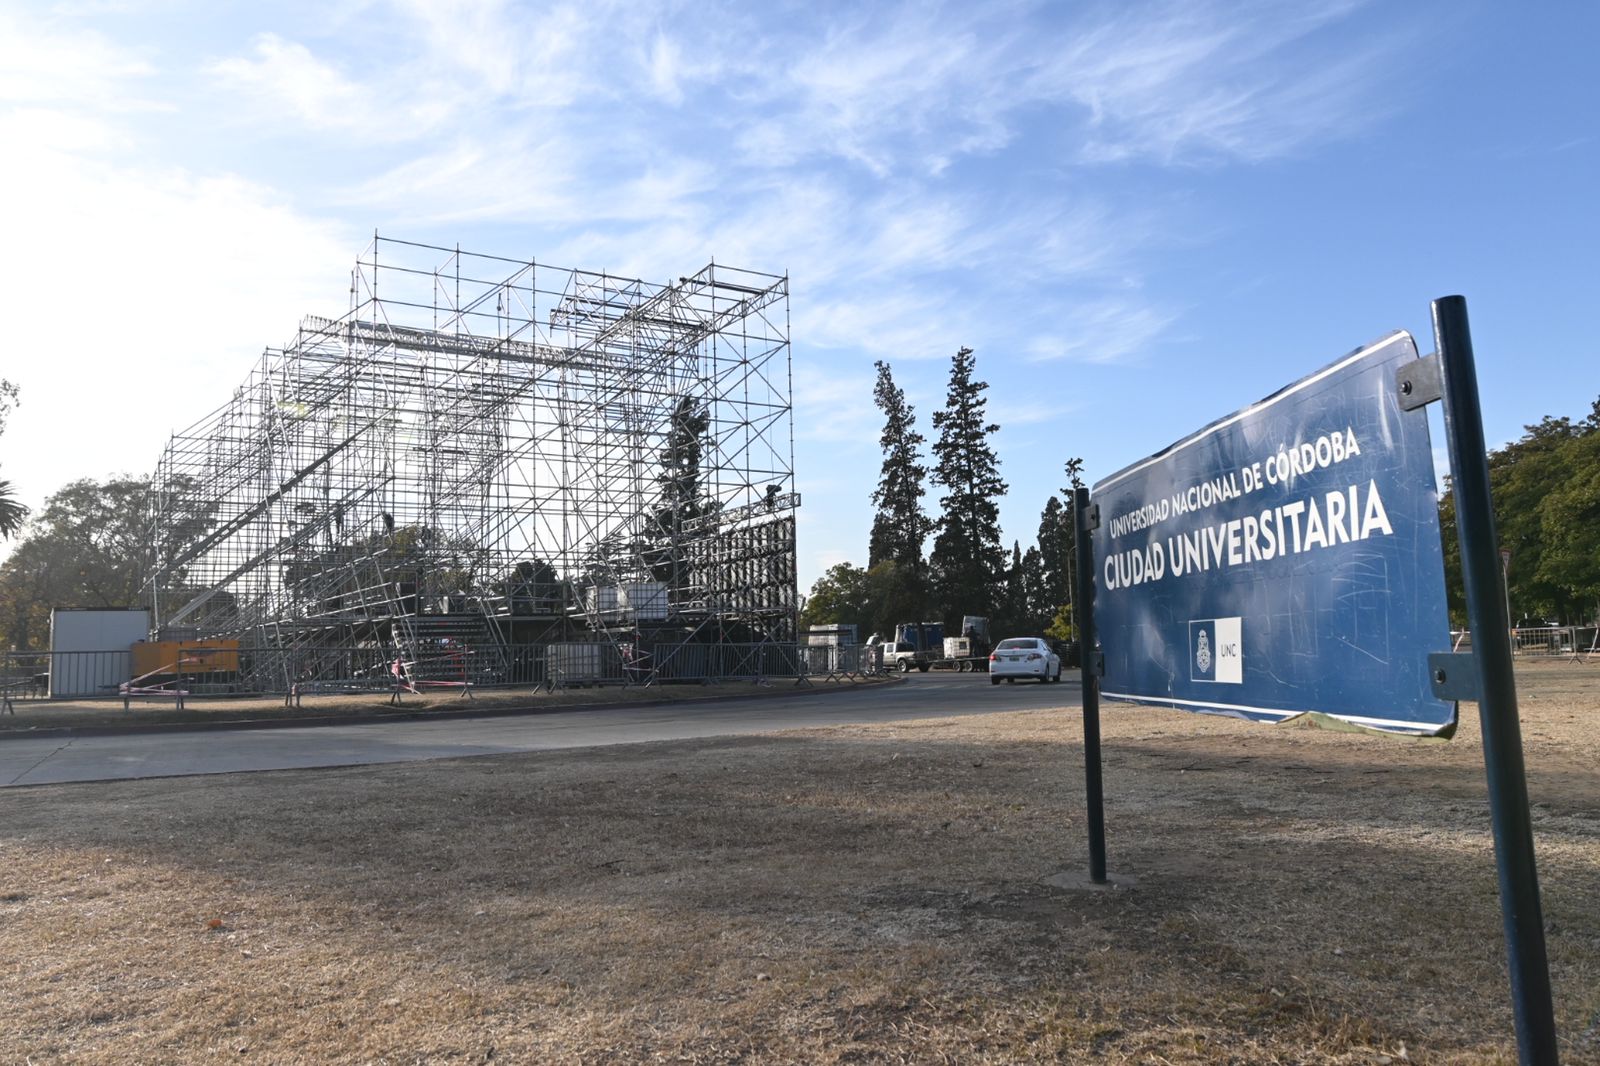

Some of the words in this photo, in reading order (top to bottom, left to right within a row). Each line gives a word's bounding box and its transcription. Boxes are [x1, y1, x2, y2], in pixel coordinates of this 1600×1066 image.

[1104, 541, 1165, 591] CIUDAD
[1169, 478, 1393, 578] UNIVERSITARIA
[1109, 498, 1169, 539] UNIVERSIDAD
[1171, 477, 1241, 518] NACIONAL
[1242, 466, 1263, 495] DE
[1265, 426, 1361, 486] CÓRDOBA
[1220, 643, 1237, 657] UNC
